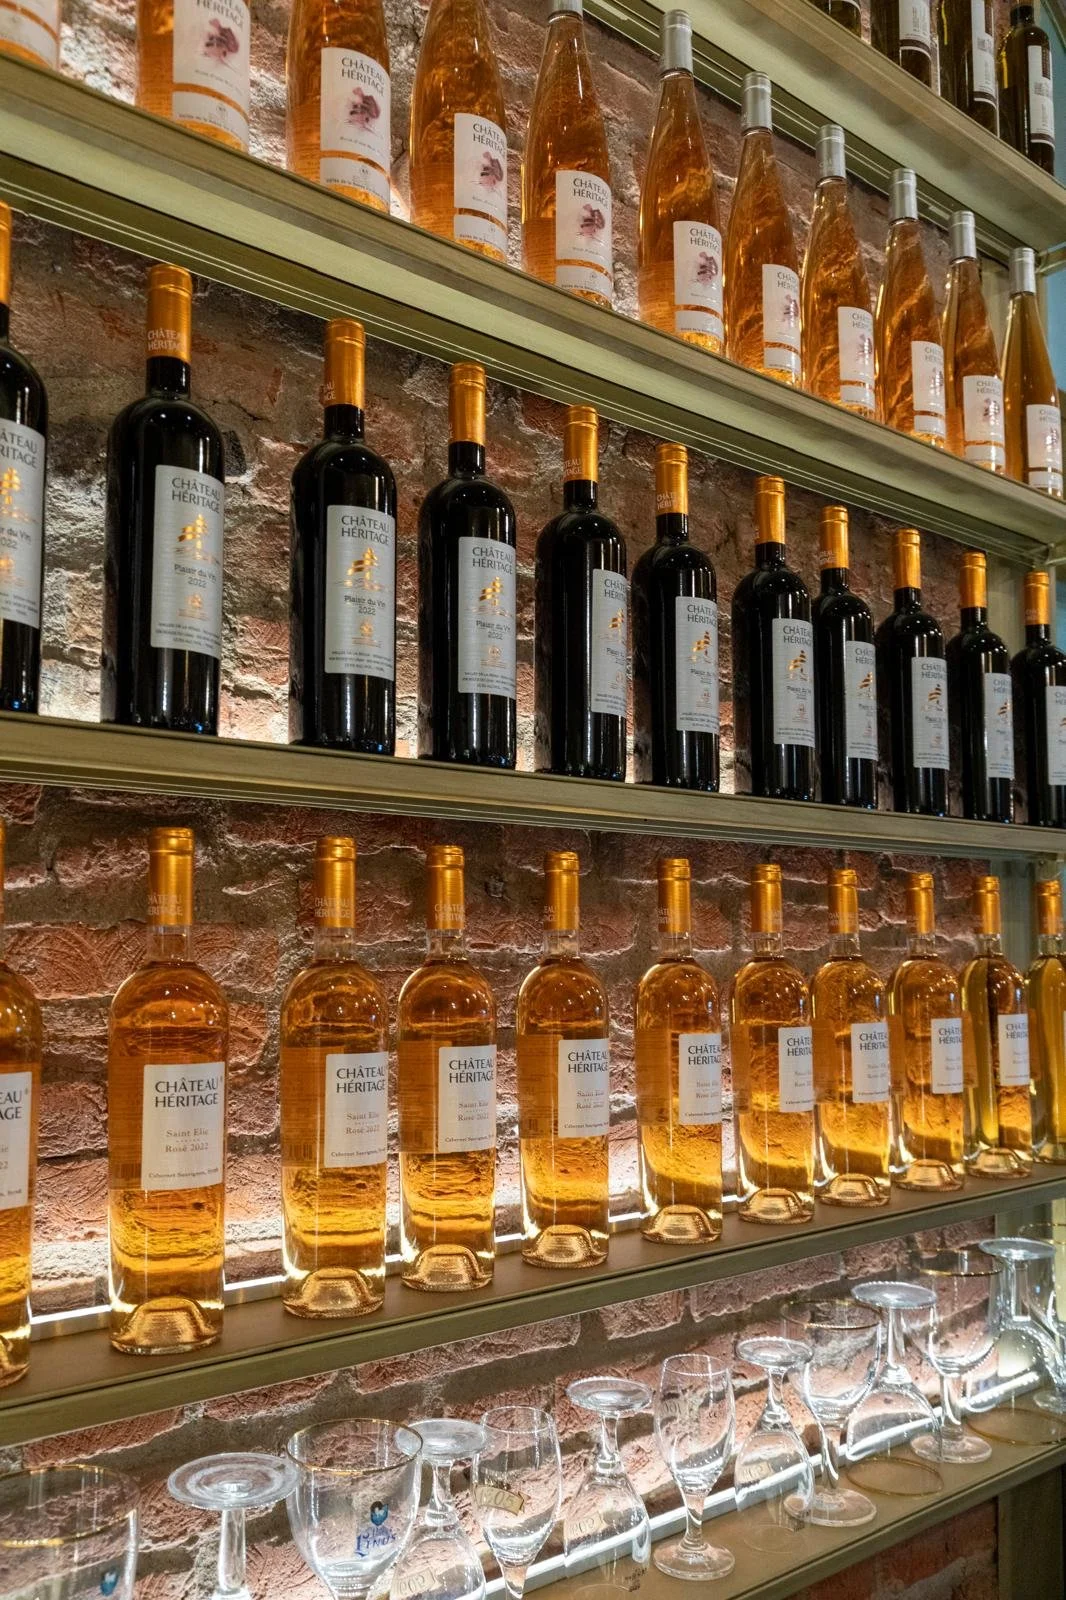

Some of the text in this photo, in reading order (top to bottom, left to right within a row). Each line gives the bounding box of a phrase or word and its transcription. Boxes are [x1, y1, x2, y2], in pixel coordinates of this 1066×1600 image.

[341, 526, 390, 546] HÉRITAGE
[155, 1077, 219, 1094] CHÂTEAU
[155, 1092, 219, 1108] HÉRITAGE
[165, 1129, 191, 1138] Saint
[165, 1142, 209, 1153] Rosé 2022
